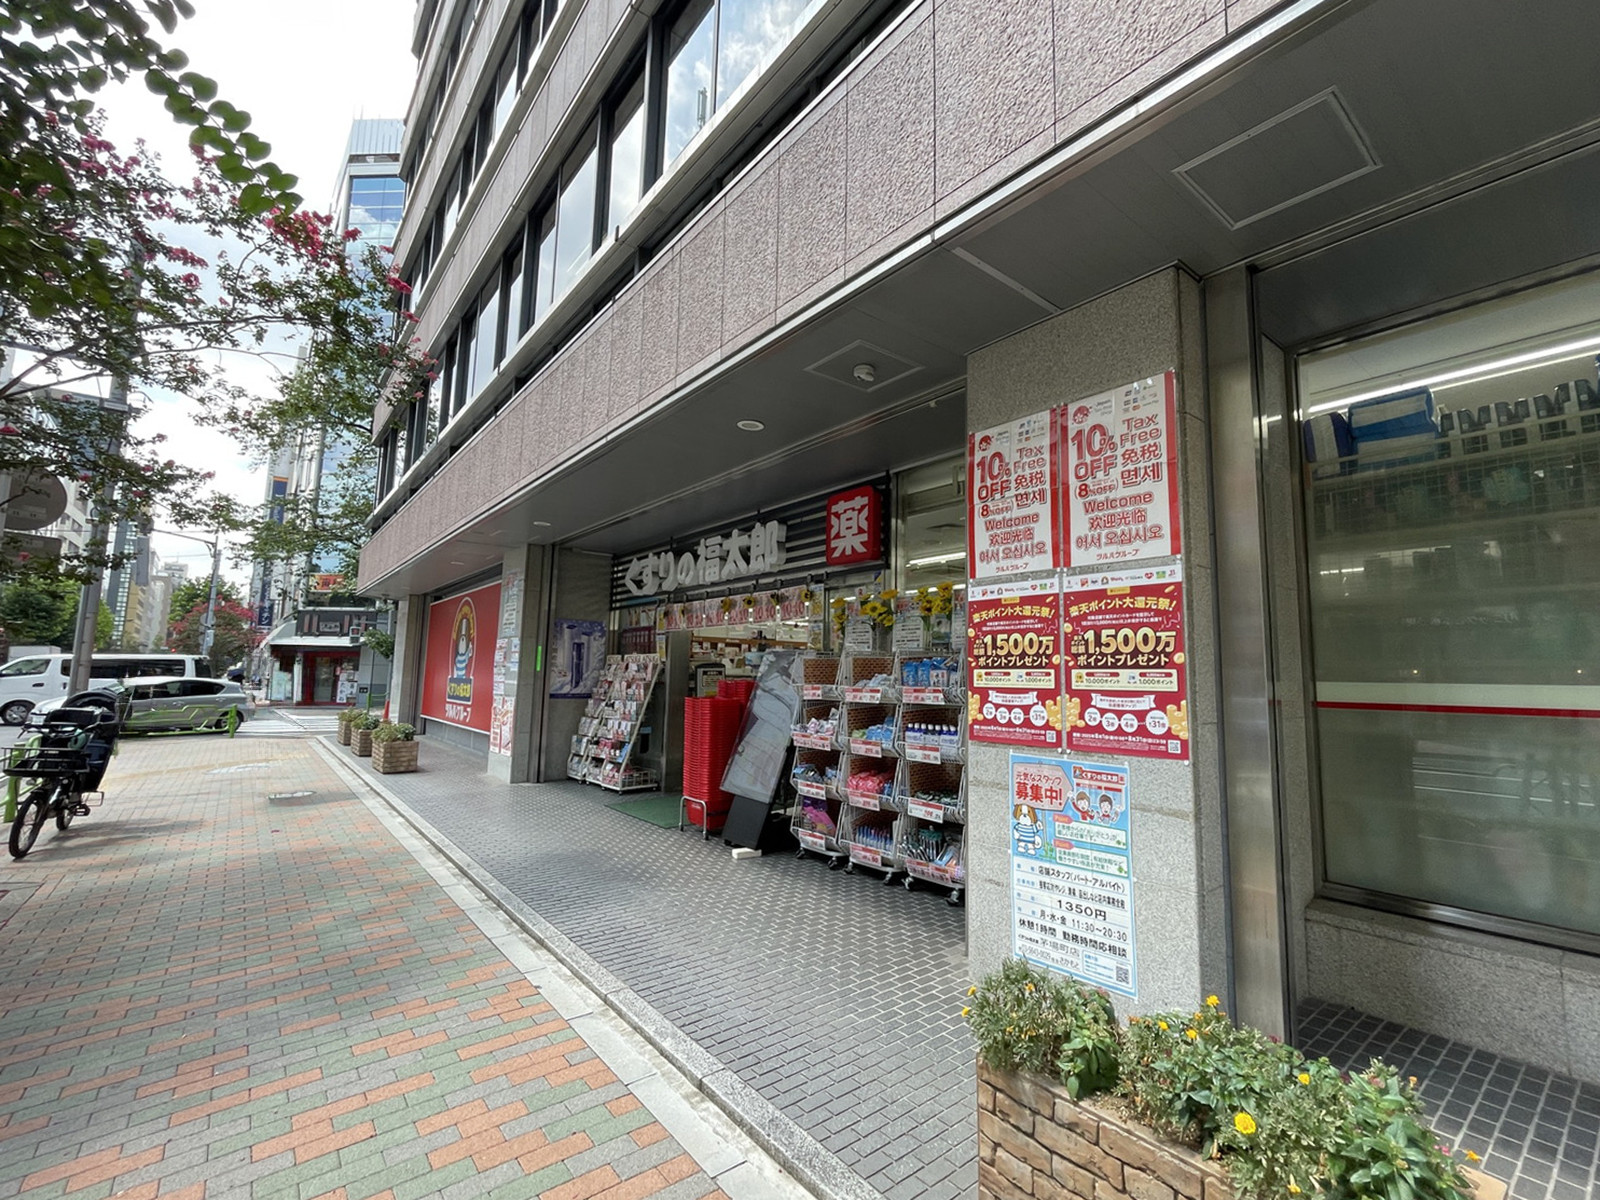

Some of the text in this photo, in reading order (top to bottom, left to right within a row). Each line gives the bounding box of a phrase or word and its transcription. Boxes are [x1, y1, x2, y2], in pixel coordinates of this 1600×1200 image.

[1122, 414, 1159, 433] Tax
[1070, 423, 1118, 462] 10%
[1120, 427, 1162, 448] Free
[1016, 445, 1044, 460] Tax
[1121, 441, 1162, 468] 免税
[976, 451, 1012, 484] 10%
[1013, 457, 1046, 474] Free
[1074, 454, 1118, 482] OFF
[1120, 461, 1163, 488] 면세
[977, 480, 1012, 503] OFF
[1014, 470, 1046, 490] 免税
[1014, 487, 1047, 510] 면세
[1083, 491, 1154, 515] Welcome
[830, 496, 869, 558] 薬
[984, 512, 1040, 532] Welcome
[1089, 507, 1148, 532] 欢迎光临
[988, 526, 1035, 548] 欢迎光临
[1076, 523, 1165, 551] 어서 오십시오
[624, 519, 789, 597] くすりの福太郎
[979, 541, 1047, 564] 어서 오십시오
[983, 631, 1055, 656] 1,500万
[1083, 626, 1177, 655] 1,500万
[978, 655, 1049, 667] ポイントプレゼント
[1077, 653, 1170, 668] ポイントプレゼント
[1015, 771, 1062, 786] 元気なスタッフ
[1016, 782, 1063, 807] 募集中!
[1057, 899, 1107, 921] 1350円
[1063, 930, 1127, 958] 勤務時間応相談
